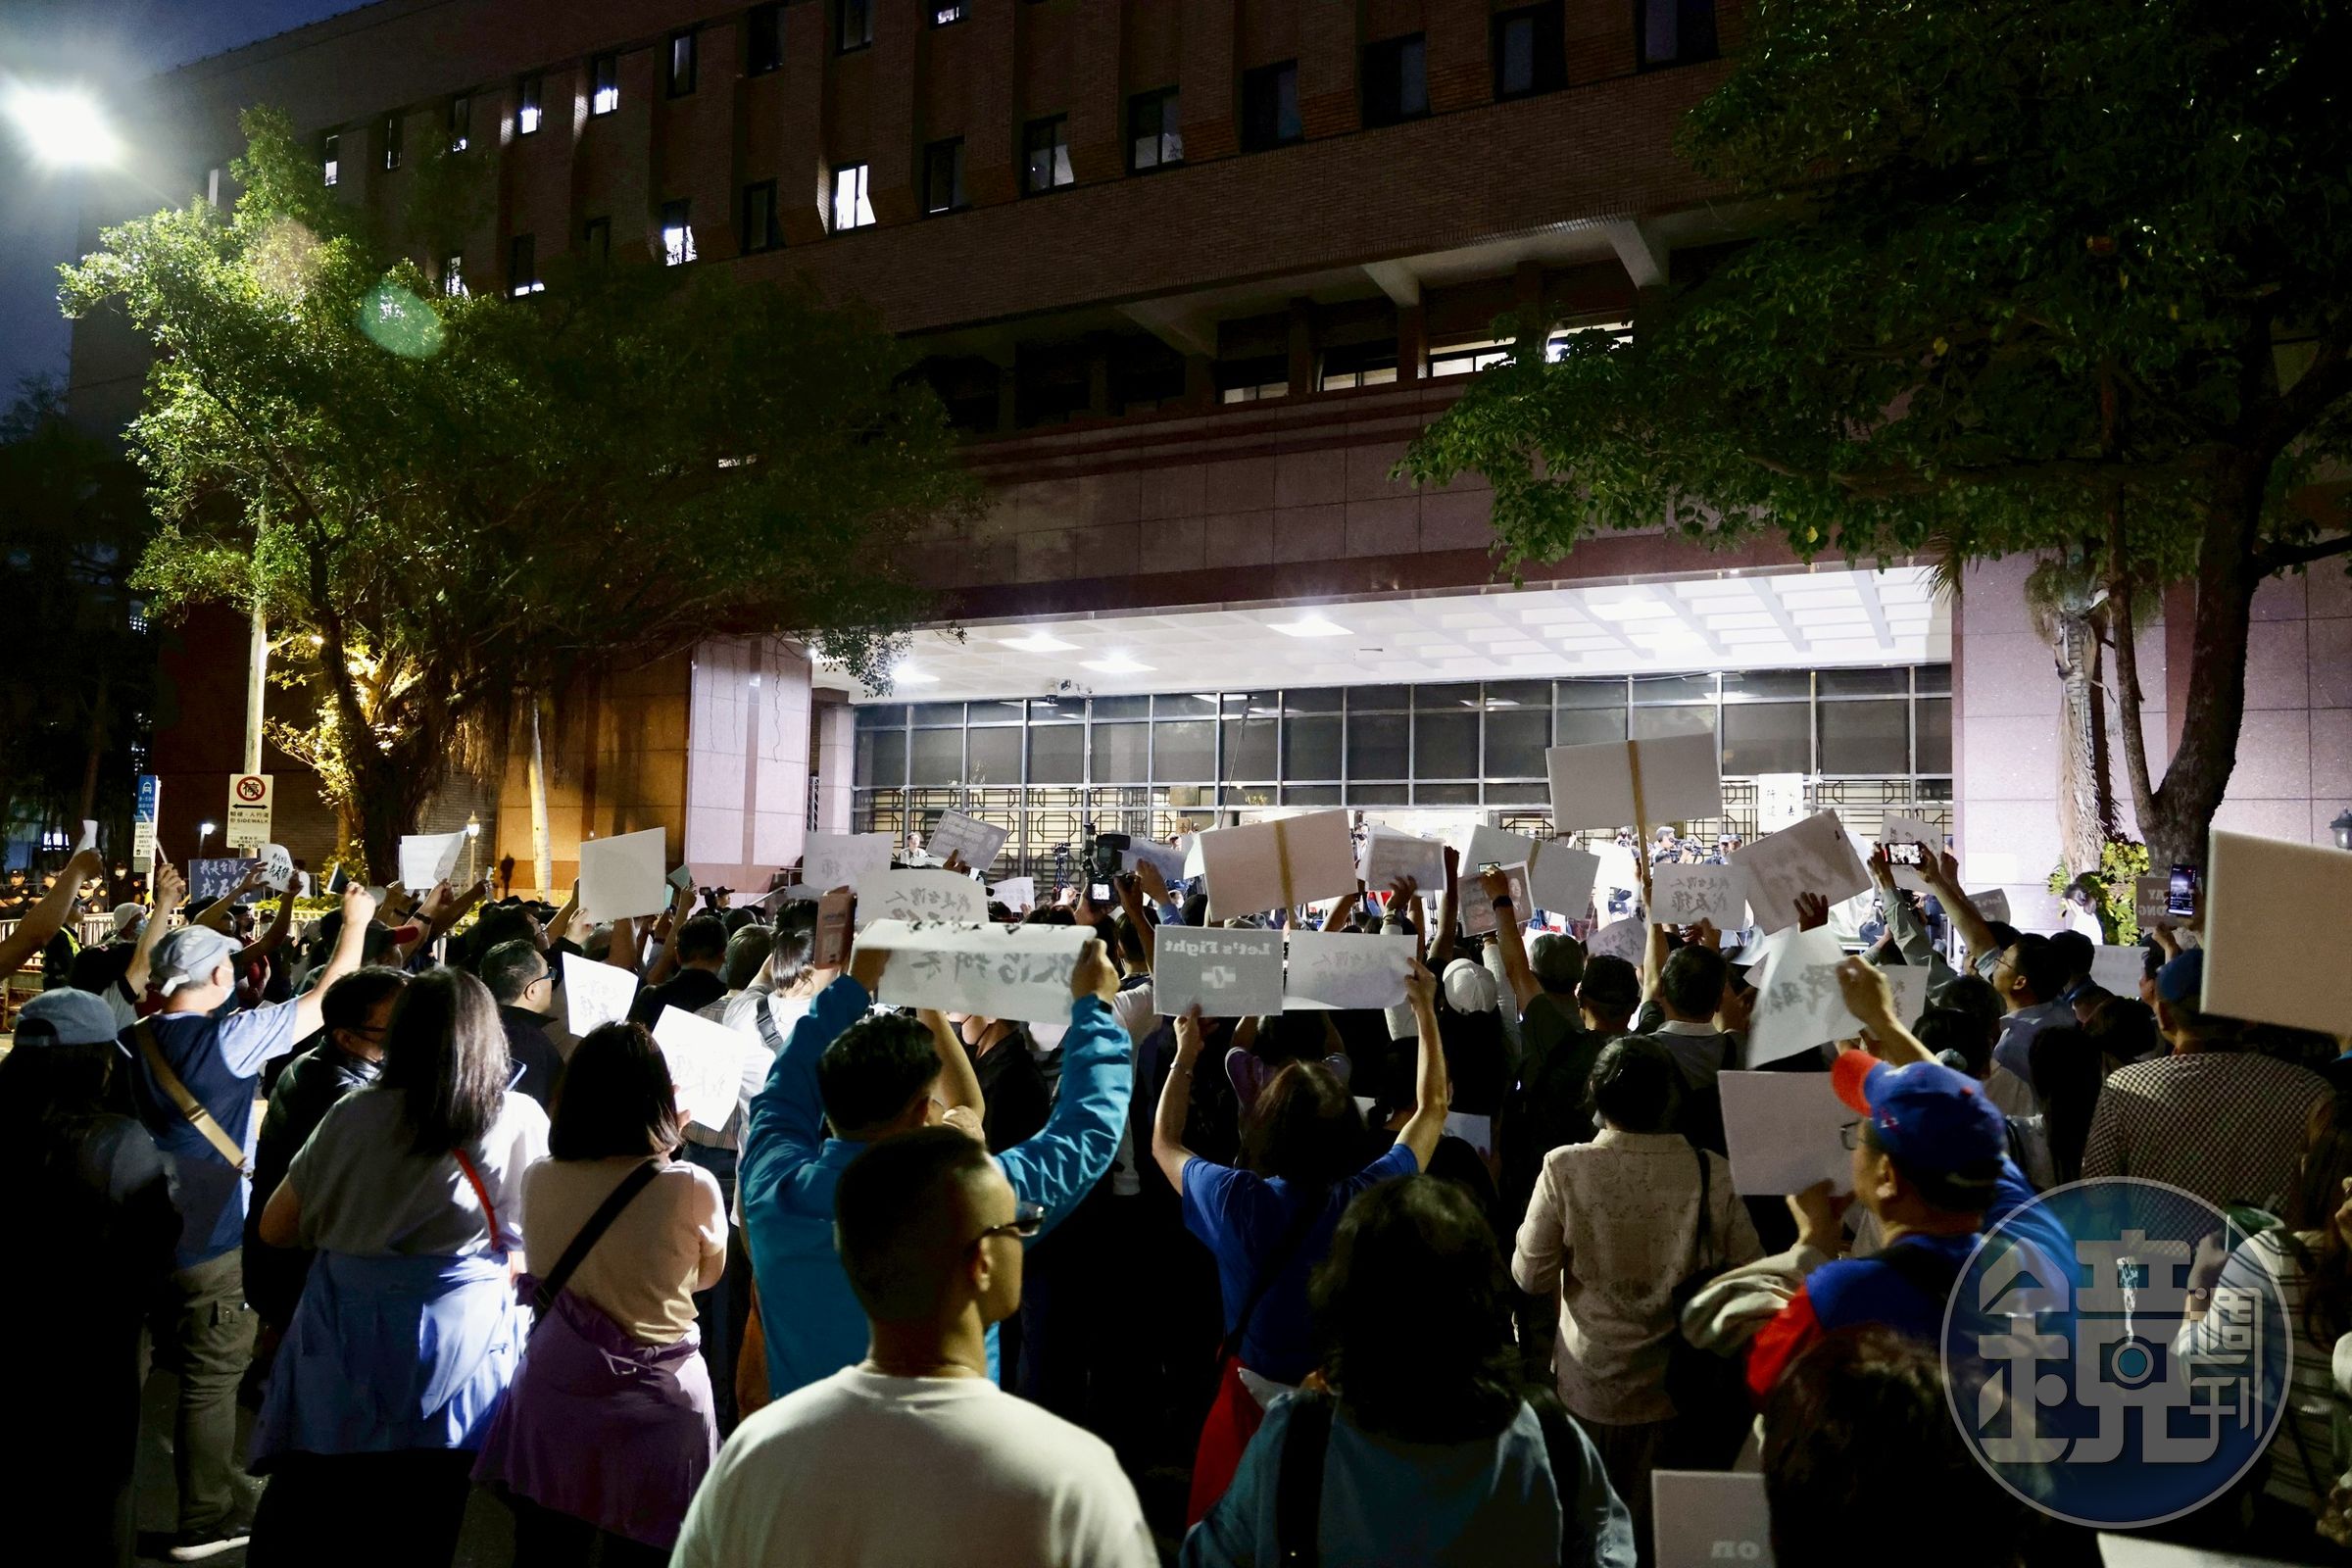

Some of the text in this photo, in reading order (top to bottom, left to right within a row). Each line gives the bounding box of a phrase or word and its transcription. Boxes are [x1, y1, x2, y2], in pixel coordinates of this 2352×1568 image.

[199, 858, 251, 876] 我是台灣人
